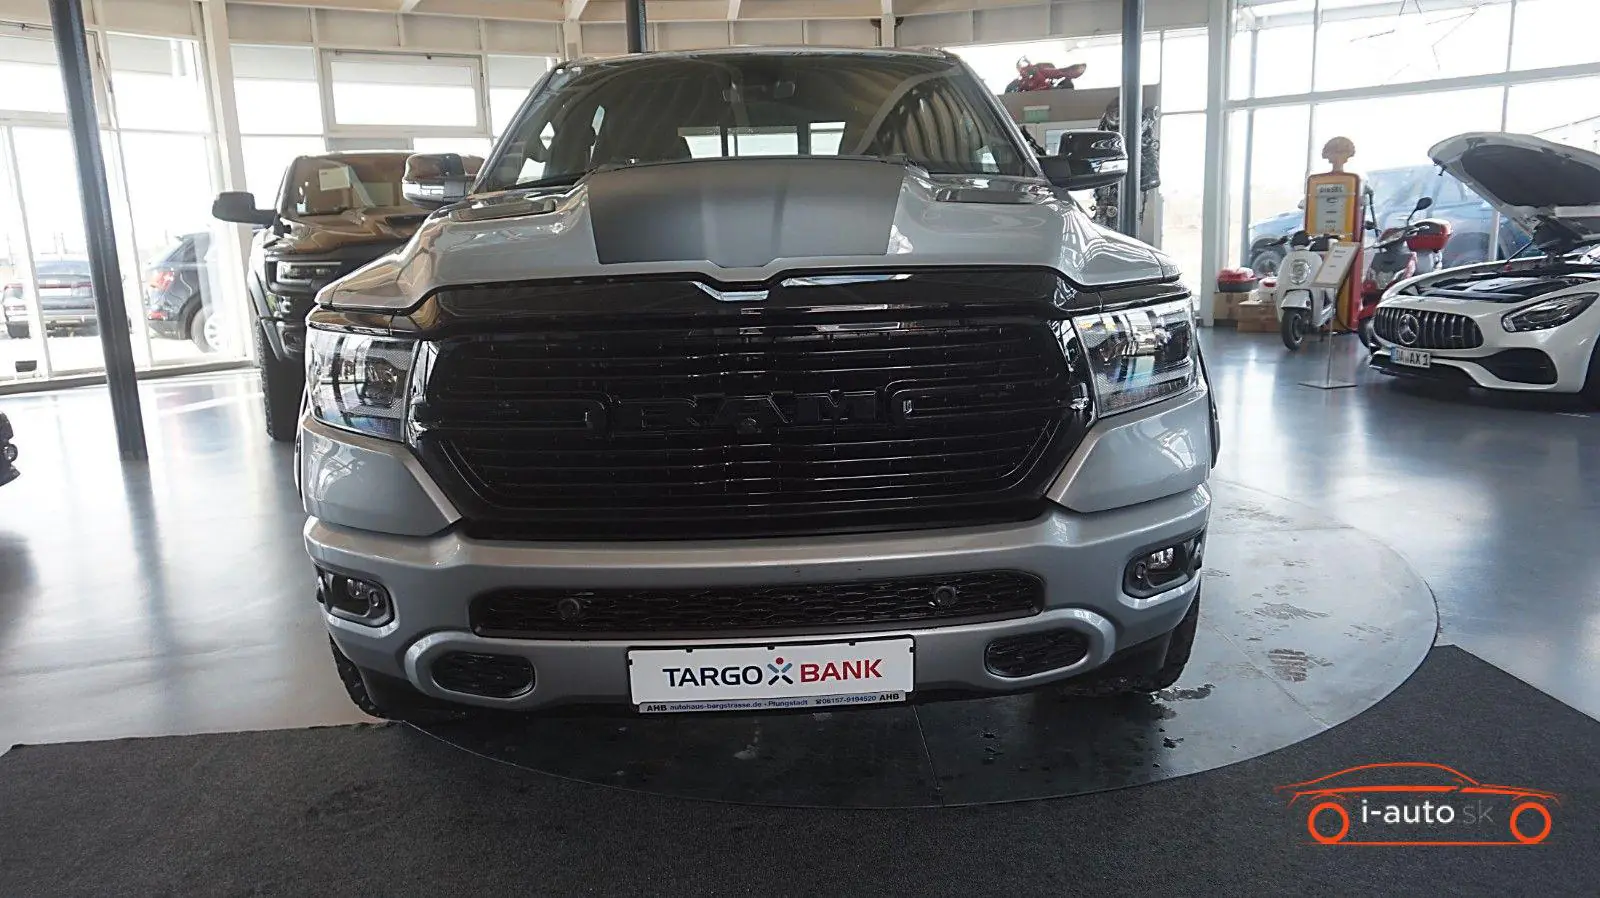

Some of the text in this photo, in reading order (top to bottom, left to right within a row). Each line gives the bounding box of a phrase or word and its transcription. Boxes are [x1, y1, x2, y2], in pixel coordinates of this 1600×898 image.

[662, 659, 883, 687] TARGO BANK
[879, 693, 900, 702] AHB
